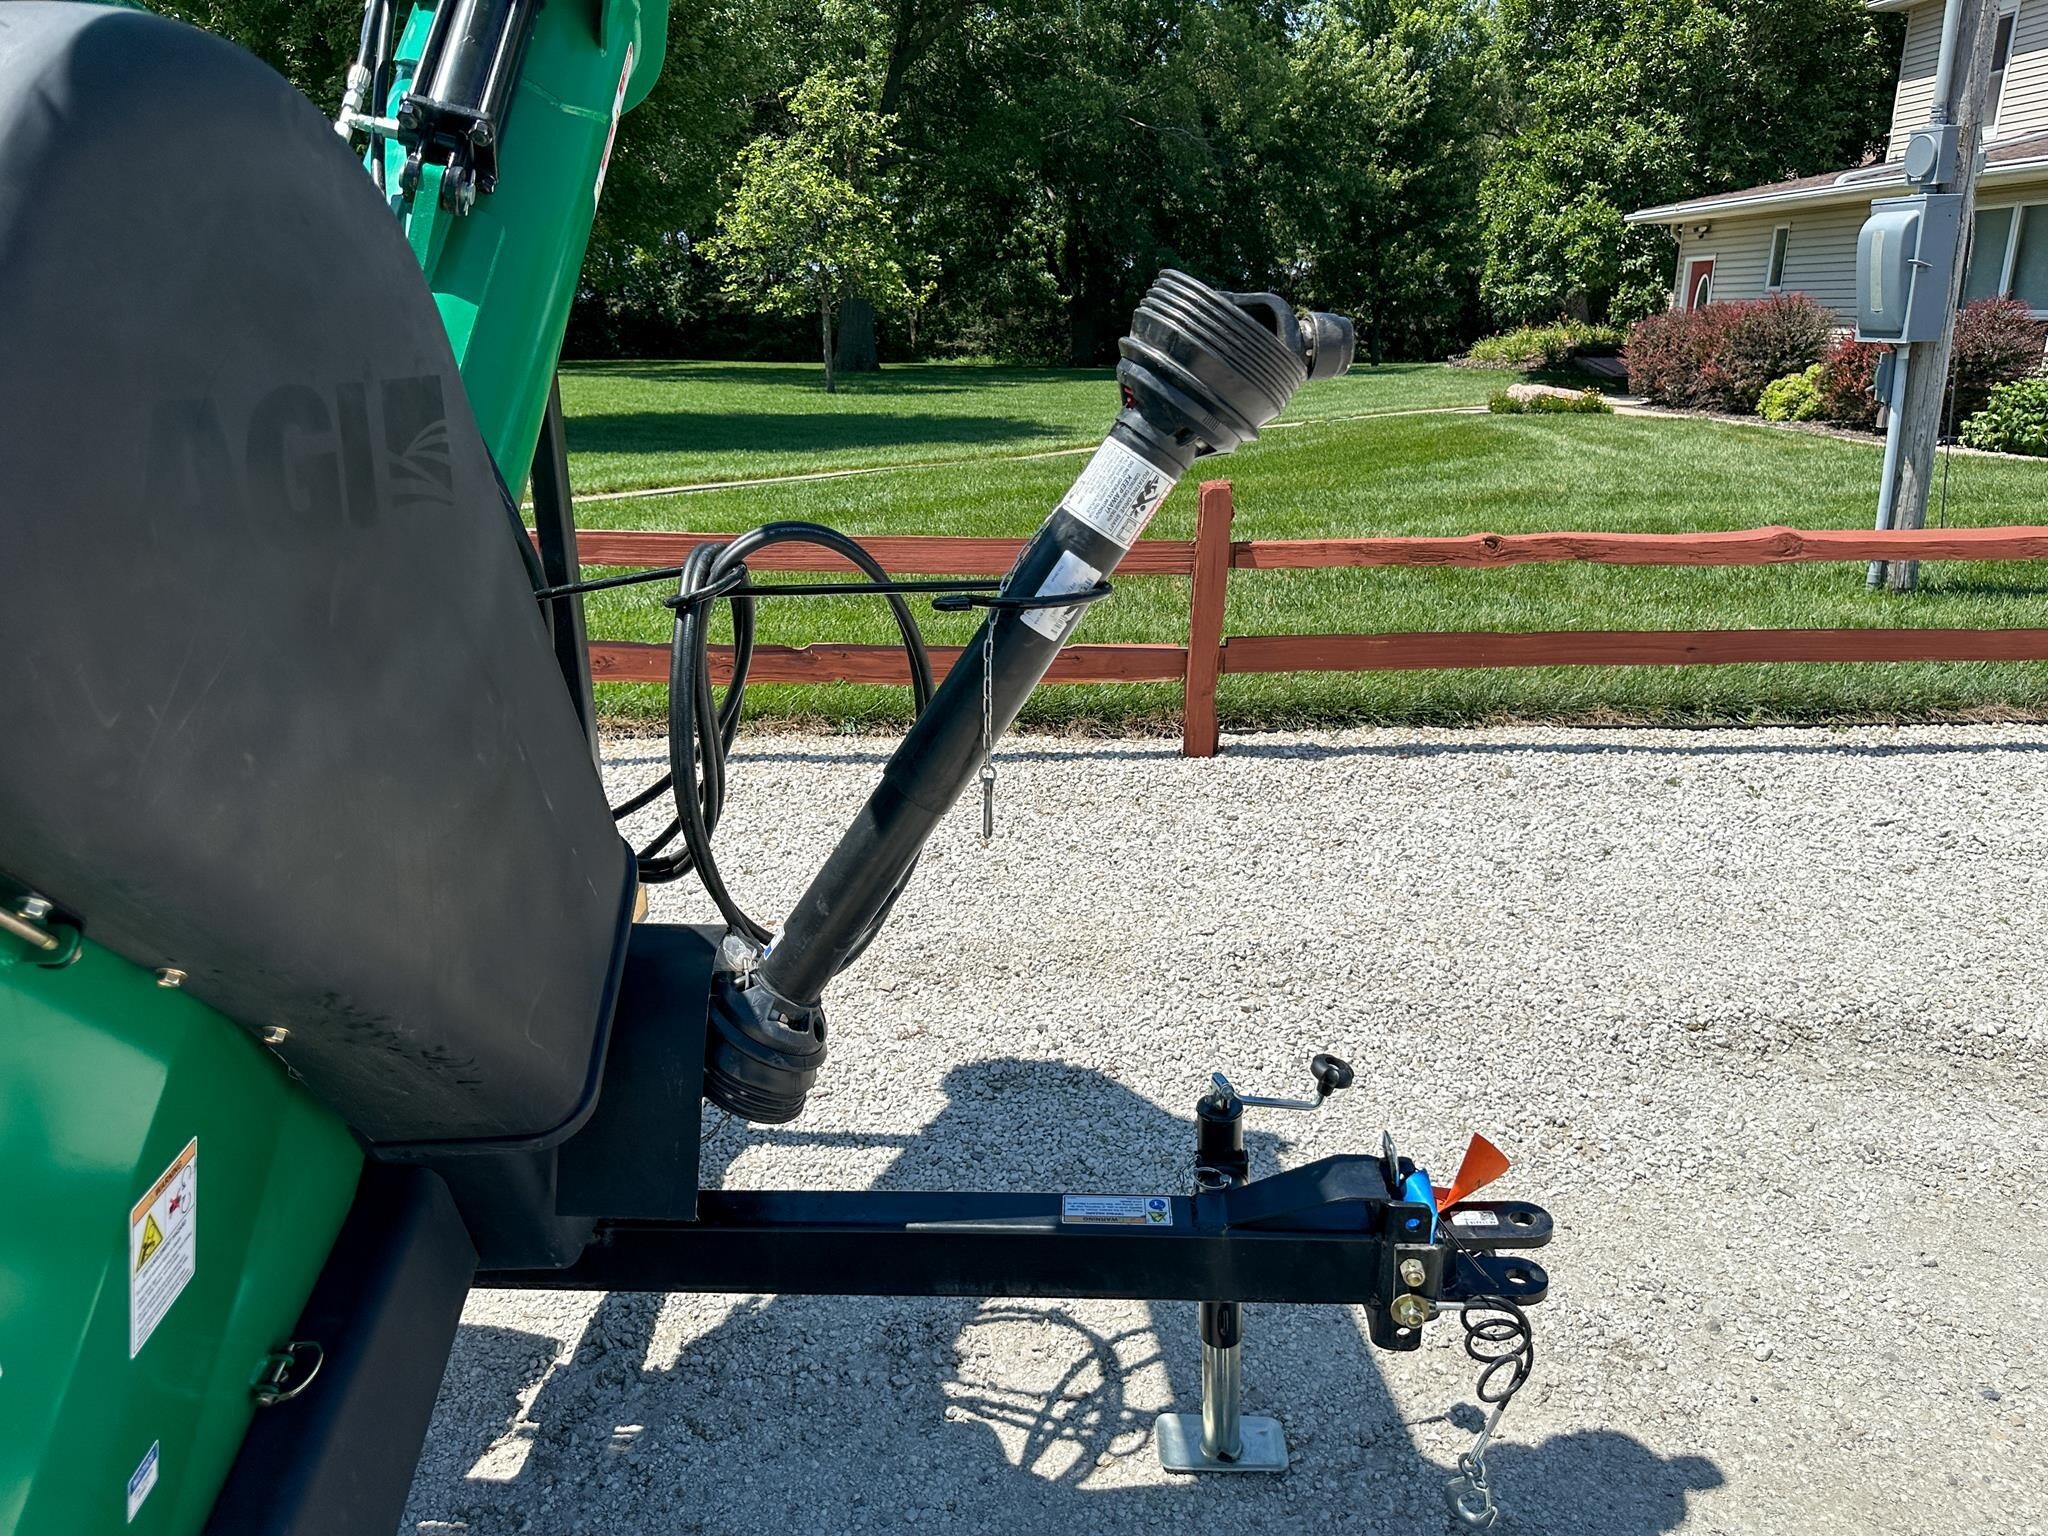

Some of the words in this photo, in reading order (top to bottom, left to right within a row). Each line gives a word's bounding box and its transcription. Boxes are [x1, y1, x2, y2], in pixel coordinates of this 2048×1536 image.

[141, 380, 382, 534] AGI
[1127, 460, 1134, 469] DO
[1120, 467, 1130, 479] NOT
[1127, 472, 1142, 490] CONTACT
[1107, 477, 1123, 499] OPERATE
[1117, 474, 1133, 494] KEEP
[1129, 470, 1151, 498] ROTATING
[1122, 489, 1130, 498] CAN
[1103, 492, 1121, 514] AWAY!
[1114, 497, 1125, 510] CAUSE
[1118, 496, 1133, 514] DRIVE
[1106, 509, 1117, 522] DEATH
[1107, 513, 1122, 532] SHAFT
[155, 1159, 182, 1198] WARNING
